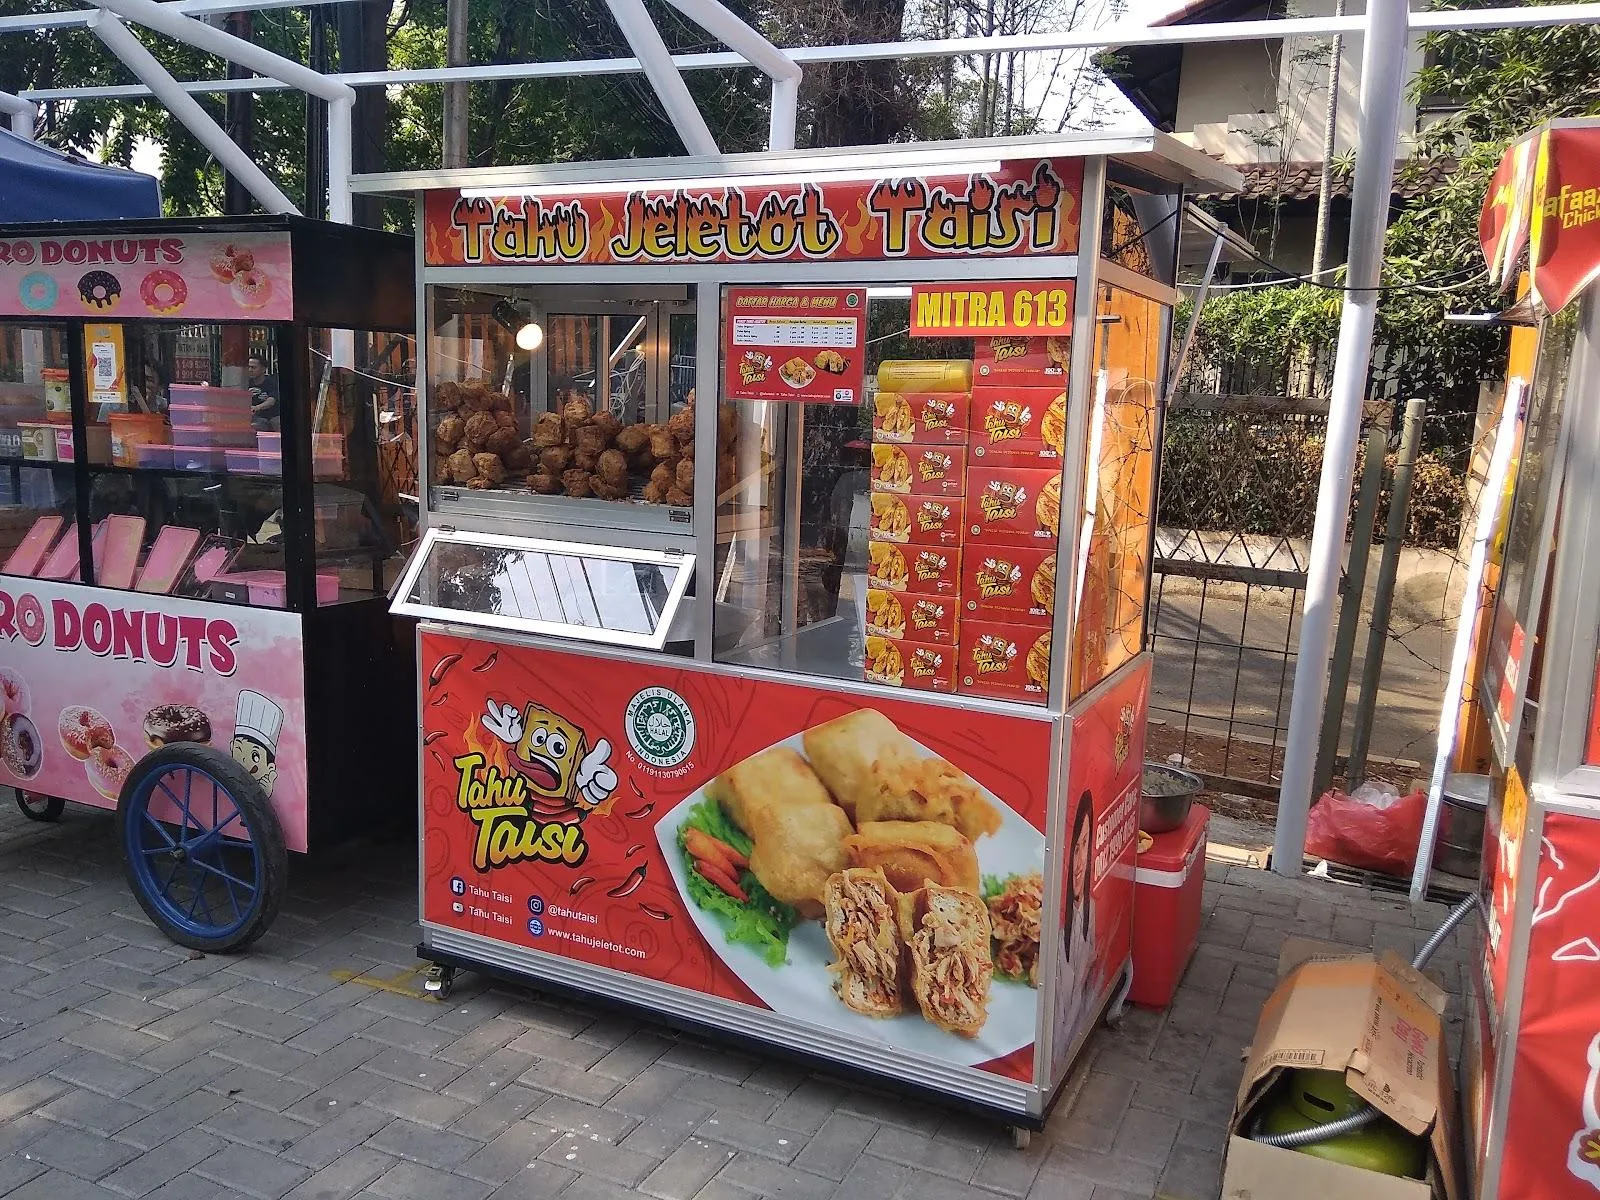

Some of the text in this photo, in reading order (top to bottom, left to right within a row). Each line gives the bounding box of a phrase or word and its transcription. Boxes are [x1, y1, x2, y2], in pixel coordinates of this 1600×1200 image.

[452, 160, 1060, 261] Tahu Jeletot Taisi
[40, 238, 185, 264] DONUTS
[917, 289, 1067, 328] MITRA 613
[993, 344, 1027, 363] Taisi
[985, 414, 1006, 429] Tahu
[989, 426, 1021, 445] Taisi
[984, 506, 1017, 524] Taisi
[980, 582, 1012, 600] Taisi
[52, 598, 240, 677] DONUTS
[977, 659, 1008, 676] Taisi
[628, 689, 693, 726] MAJELIS ULAMA
[634, 744, 687, 765] INDONESIA
[453, 752, 528, 808] Tahu
[471, 806, 586, 871] Taisi
[469, 884, 513, 904] Tahu Taisi
[469, 905, 513, 925] Tahu Taisi
[548, 904, 598, 924] @tahutaisi
[547, 927, 646, 959] www.tahujeletot.com
